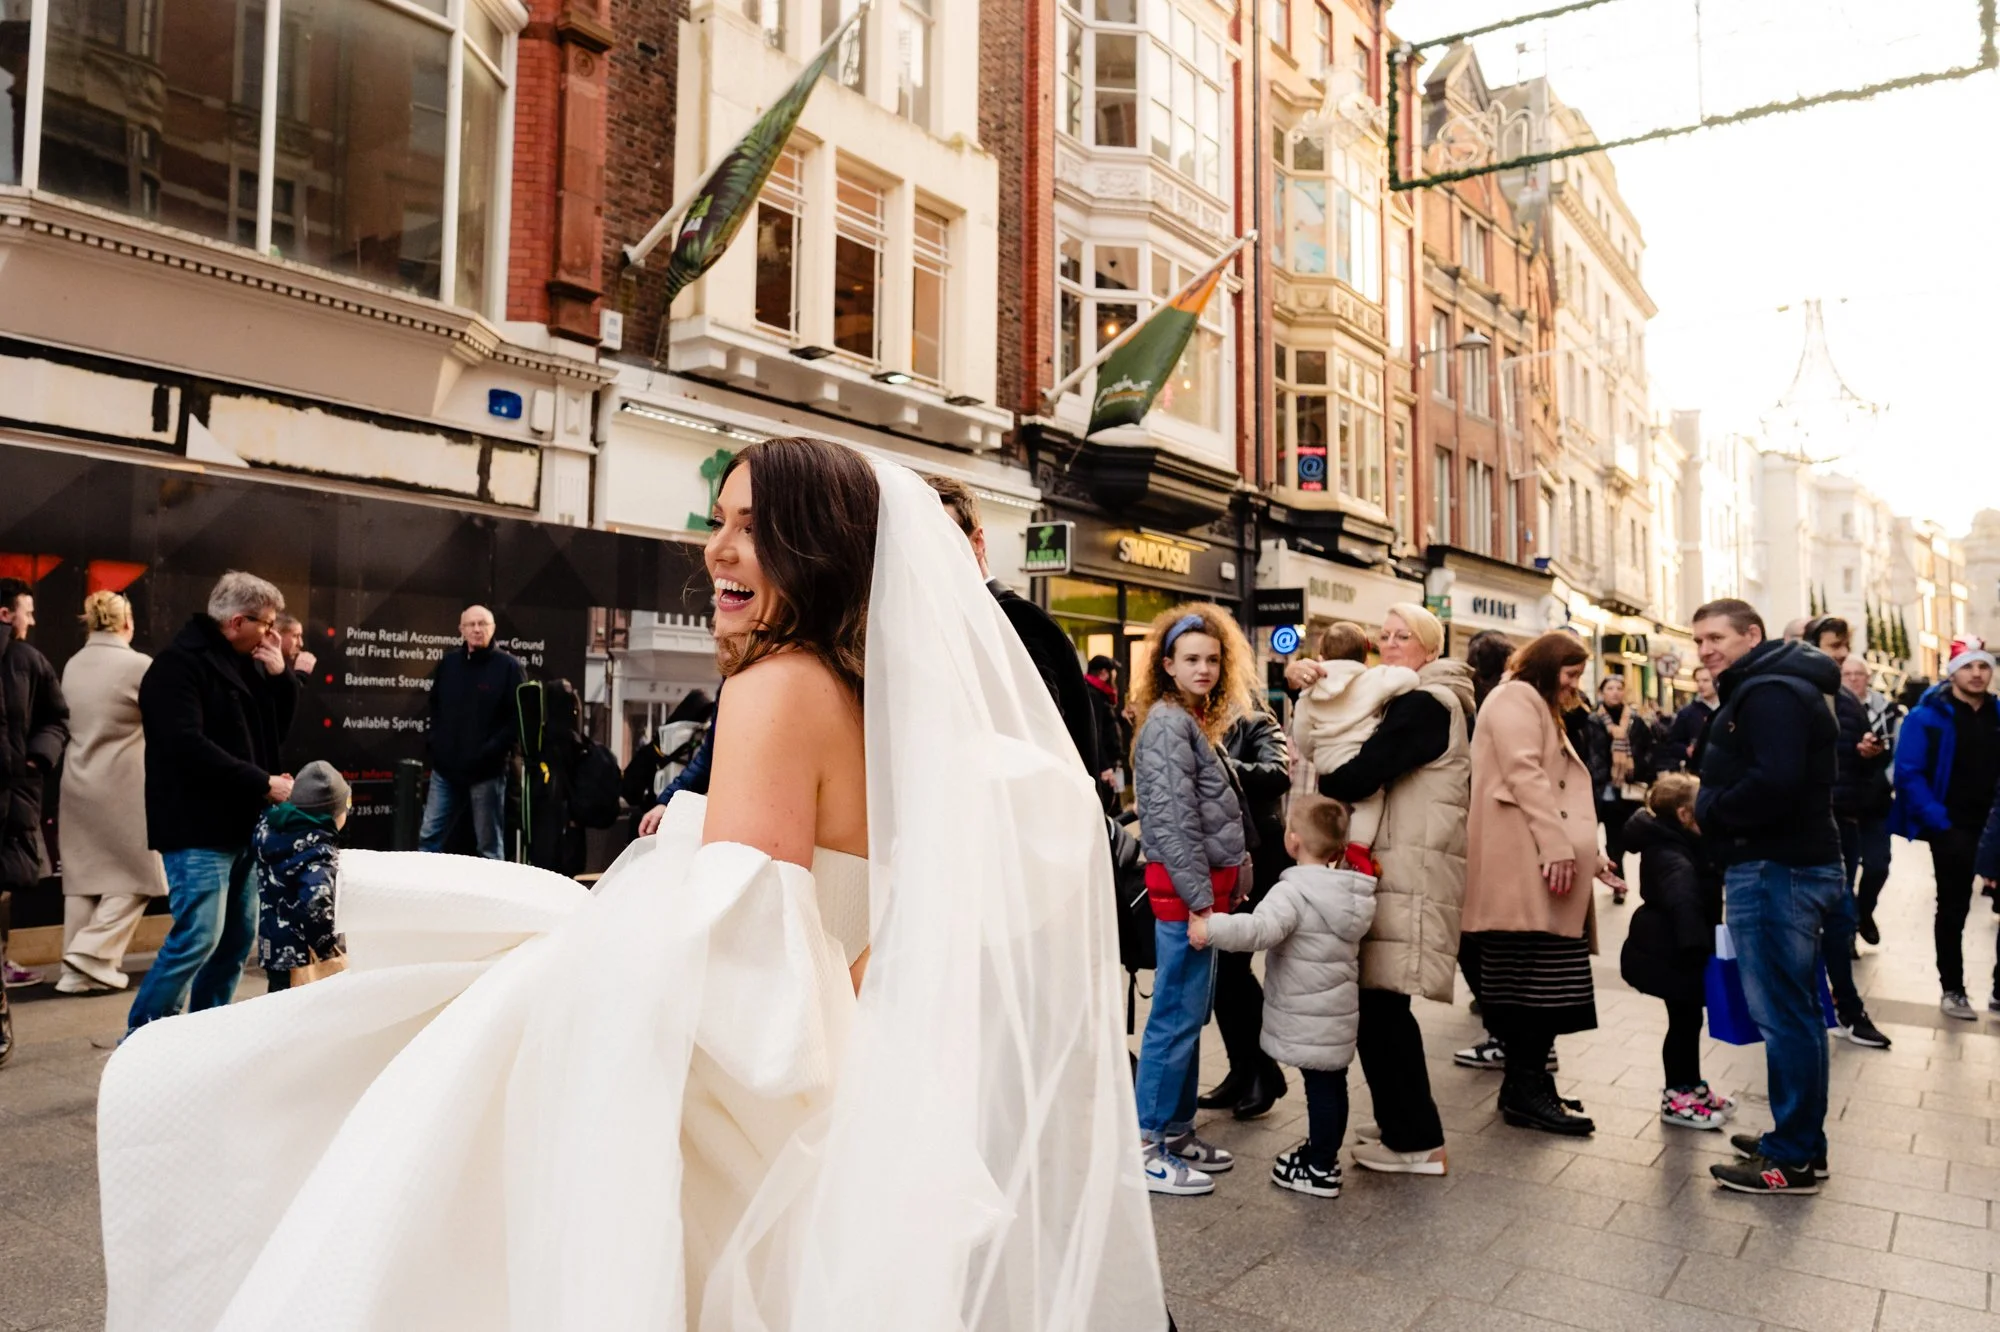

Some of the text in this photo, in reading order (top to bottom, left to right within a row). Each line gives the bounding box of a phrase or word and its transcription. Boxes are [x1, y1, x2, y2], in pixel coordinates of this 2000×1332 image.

[1119, 536, 1191, 575] SWAROVSKI
[1473, 596, 1517, 619] OFFICE
[346, 626, 377, 641] Prime
[379, 628, 408, 643] Retail
[410, 631, 464, 646] Accommod
[511, 637, 545, 651] Ground
[345, 643, 366, 657] and
[368, 645, 391, 658] First
[394, 646, 424, 660] Levels
[345, 673, 396, 687] Basement
[343, 716, 390, 729] Available
[392, 716, 424, 733] Spring
[361, 769, 394, 779] Inform
[374, 804, 393, 815] 078
[1760, 1167, 1789, 1190] N
